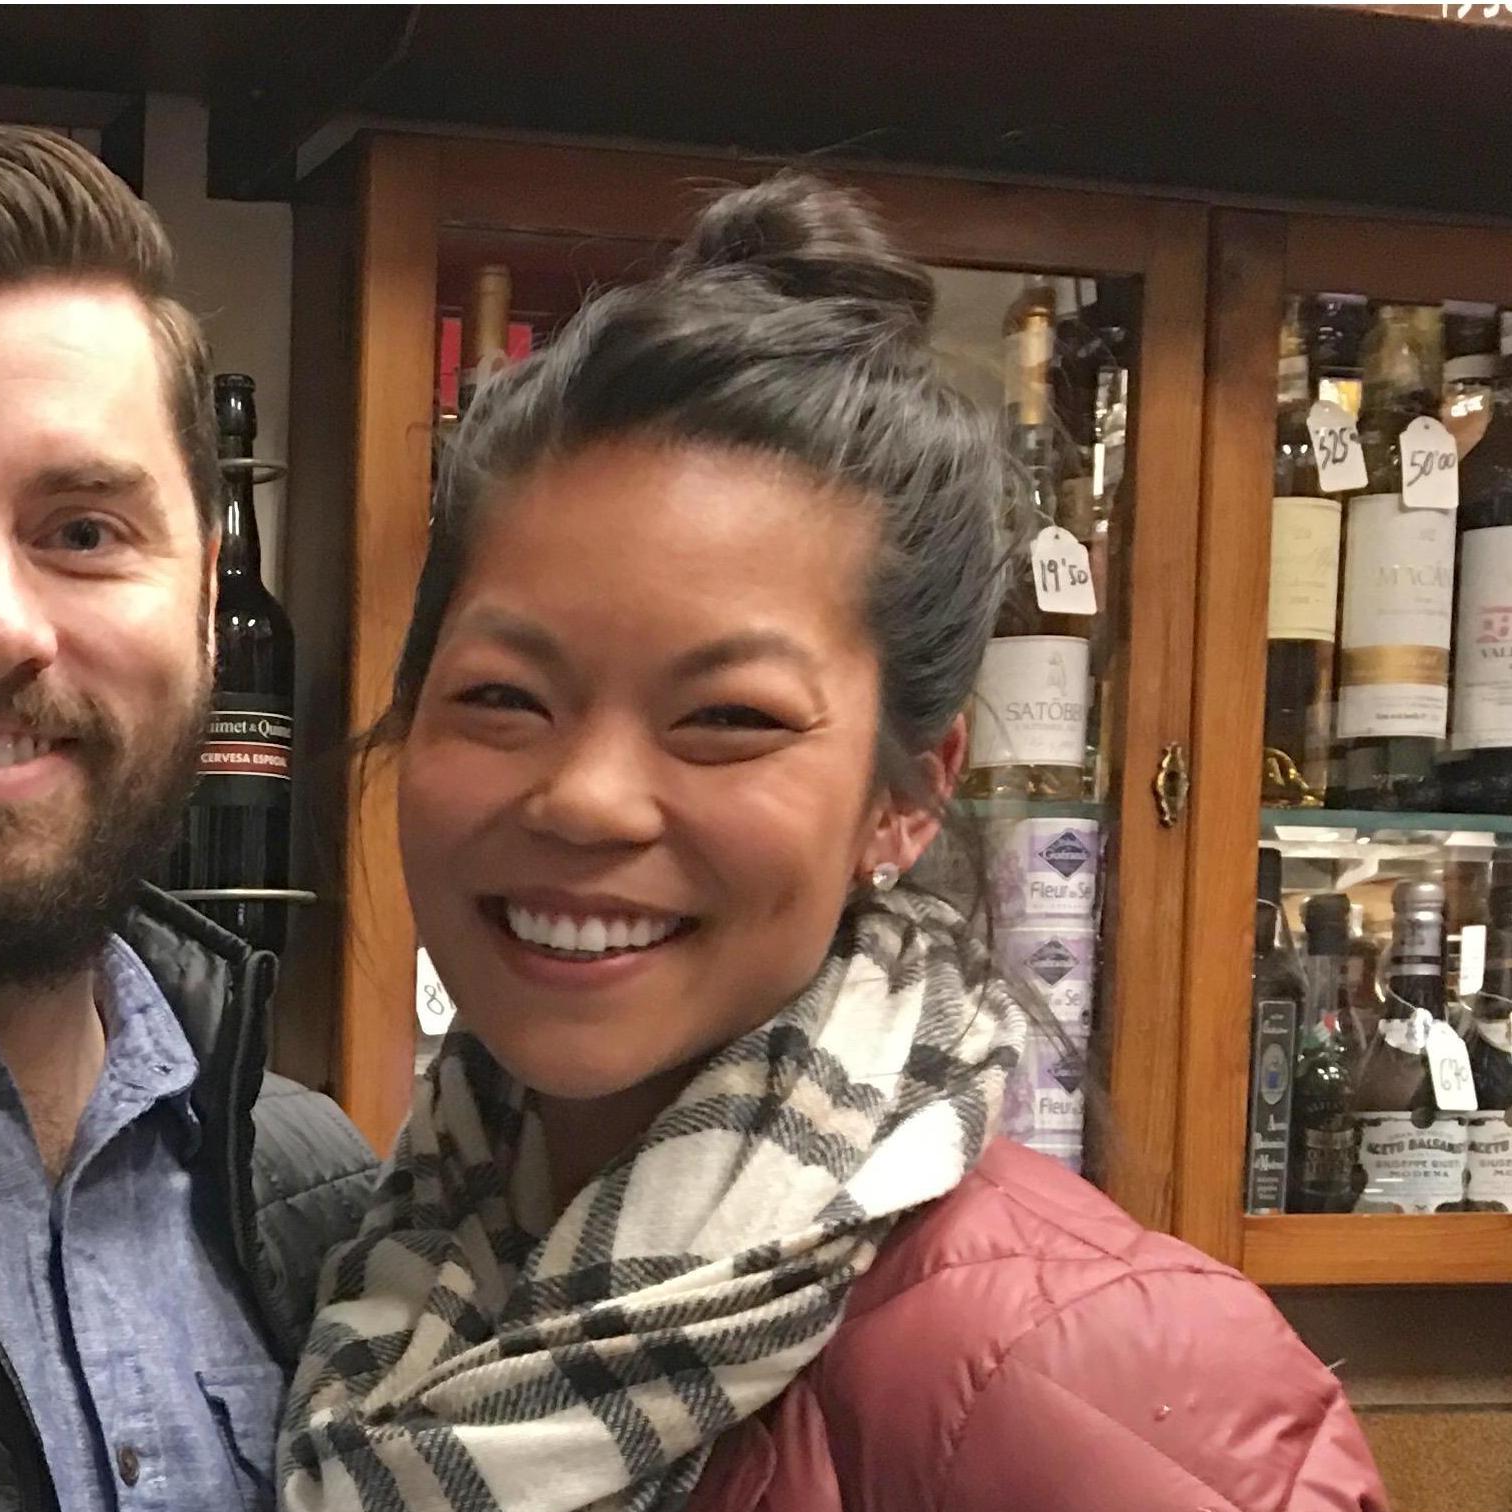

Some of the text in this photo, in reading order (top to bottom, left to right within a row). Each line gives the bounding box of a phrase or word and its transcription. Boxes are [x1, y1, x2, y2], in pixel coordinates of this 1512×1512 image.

[200, 752, 250, 763] CERVESA
[1030, 881, 1069, 899] Fleur
[1039, 1097, 1072, 1115] Fleur
